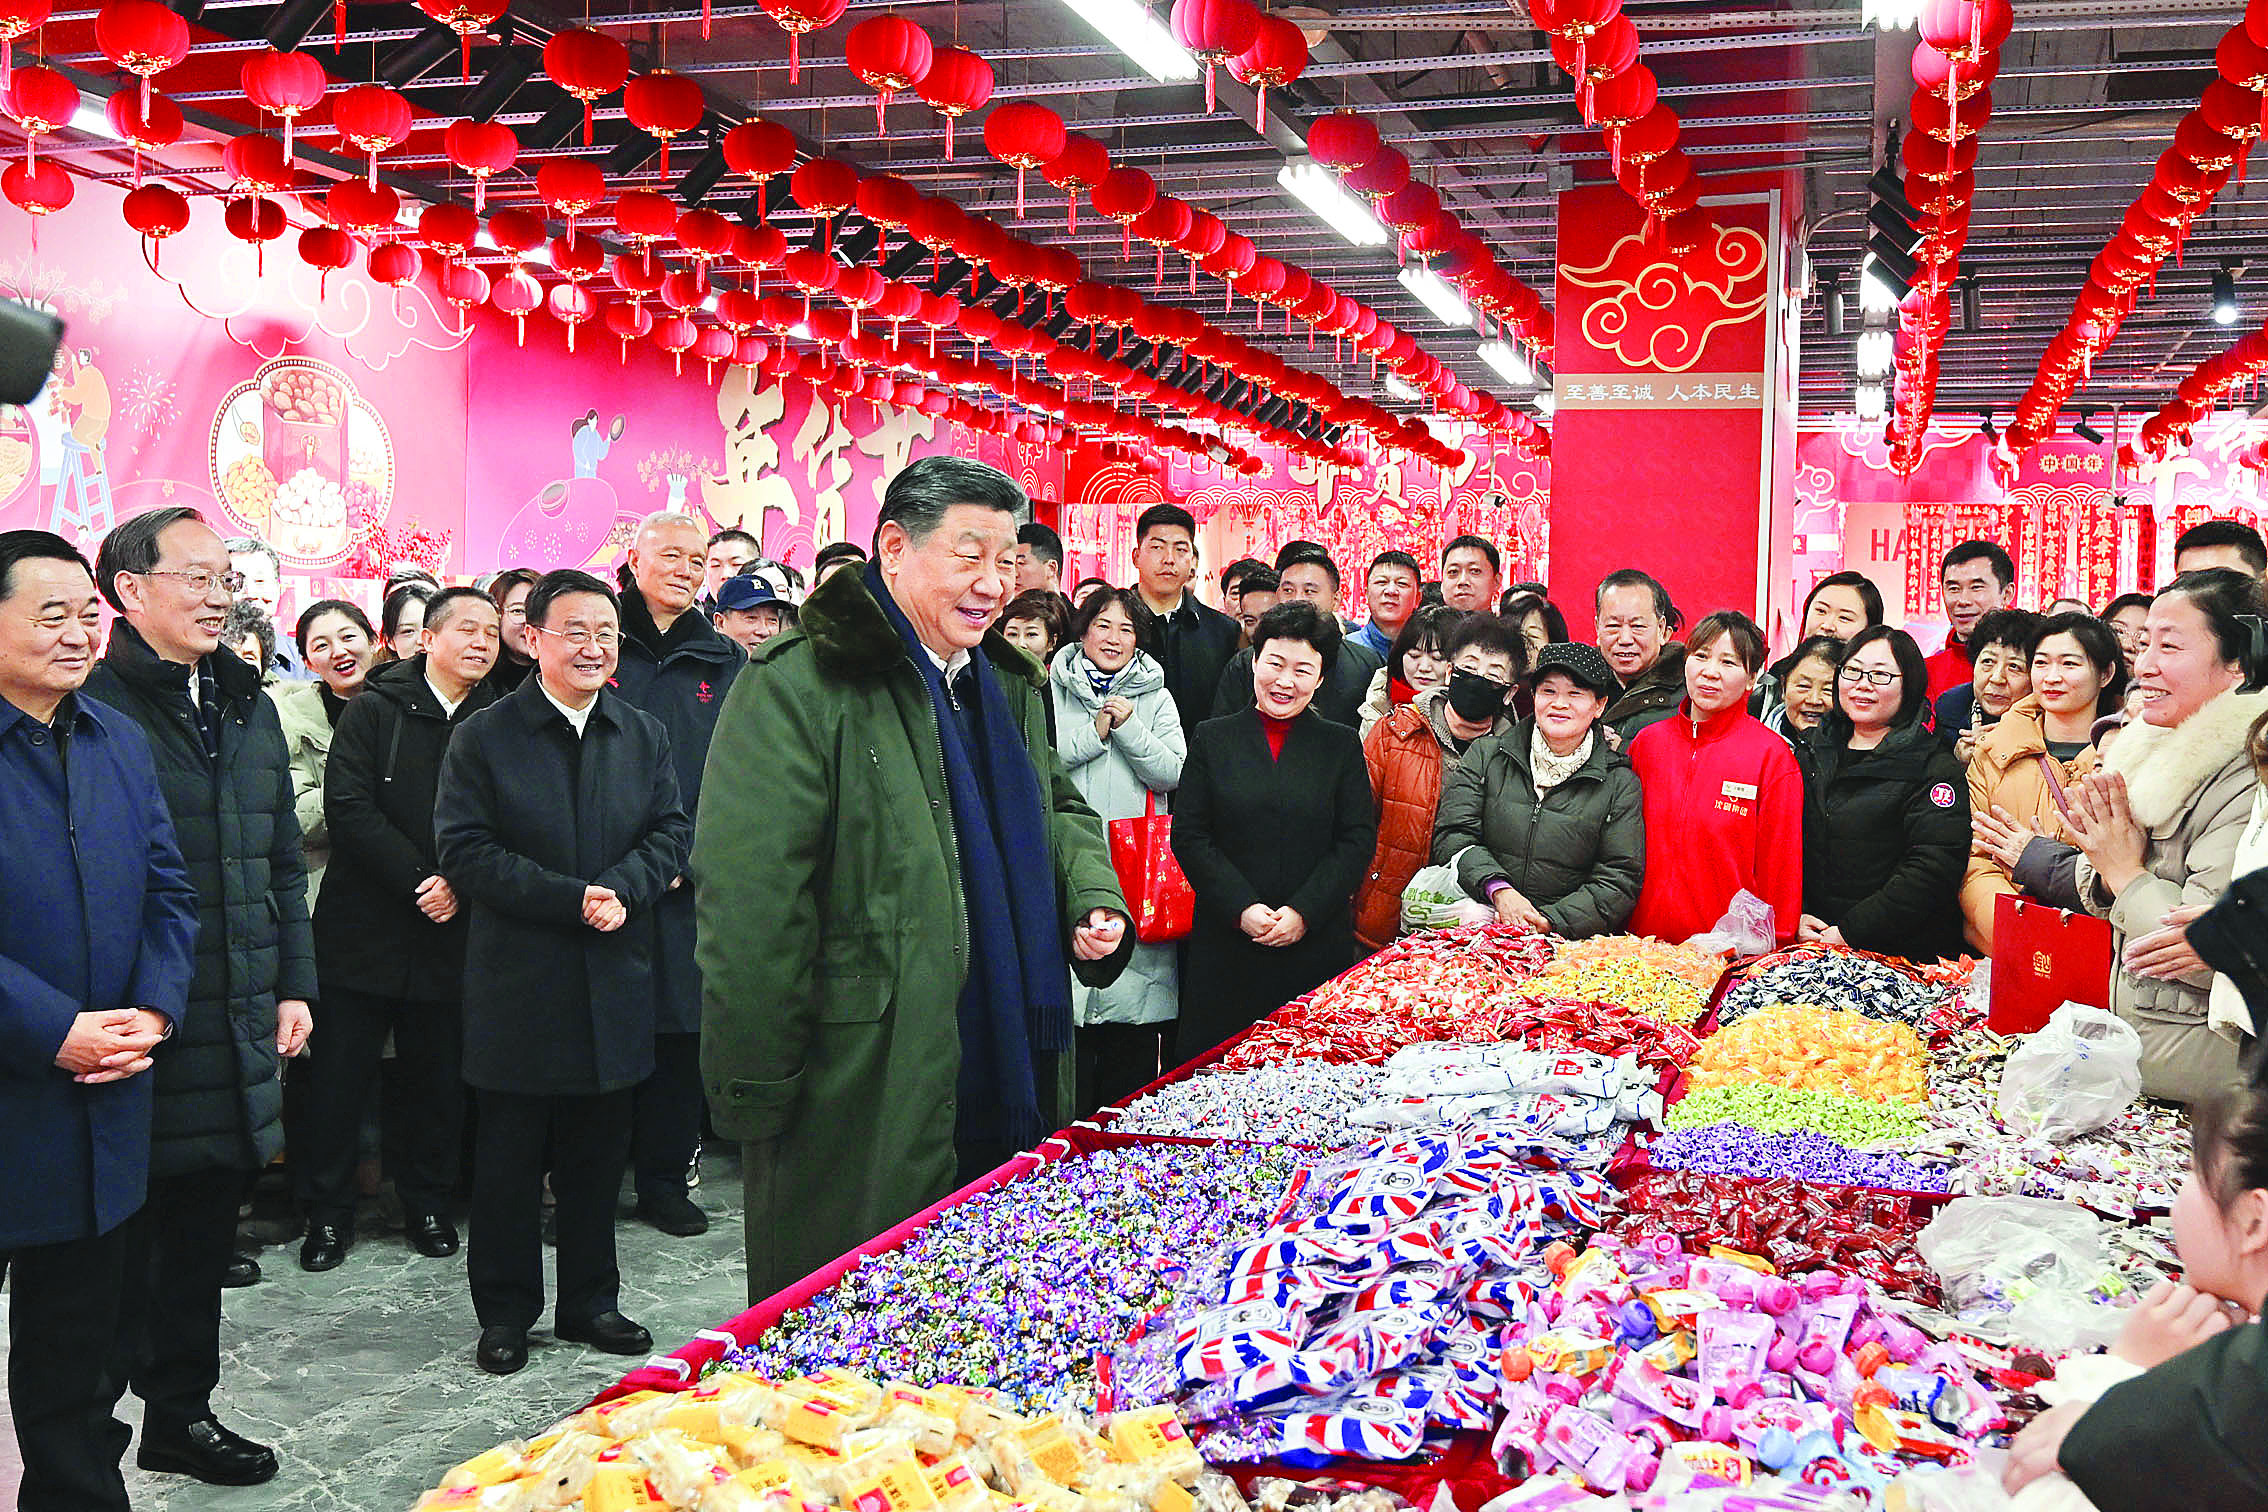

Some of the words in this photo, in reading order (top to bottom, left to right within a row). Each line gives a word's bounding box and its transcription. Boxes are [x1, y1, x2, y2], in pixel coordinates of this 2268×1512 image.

[1563, 383, 1655, 401] 至善至诚
[1666, 383, 1760, 401] 人本民生
[2042, 455, 2101, 472] 中国年
